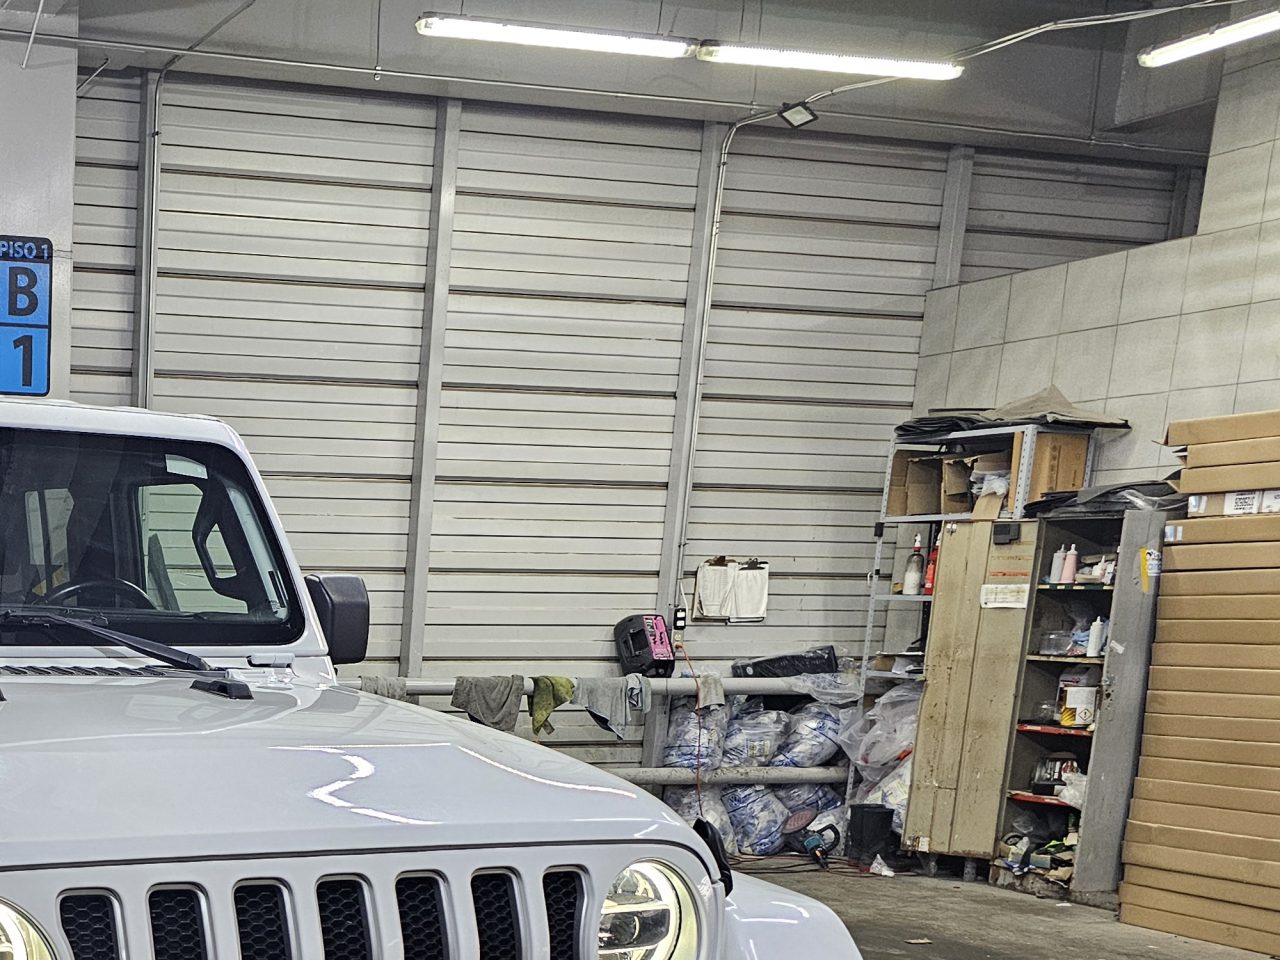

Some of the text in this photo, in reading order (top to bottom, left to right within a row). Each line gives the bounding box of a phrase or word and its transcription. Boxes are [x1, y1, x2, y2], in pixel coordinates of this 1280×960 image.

[41, 244, 49, 260] 1
[8, 266, 39, 317] B
[12, 334, 33, 387] 1
